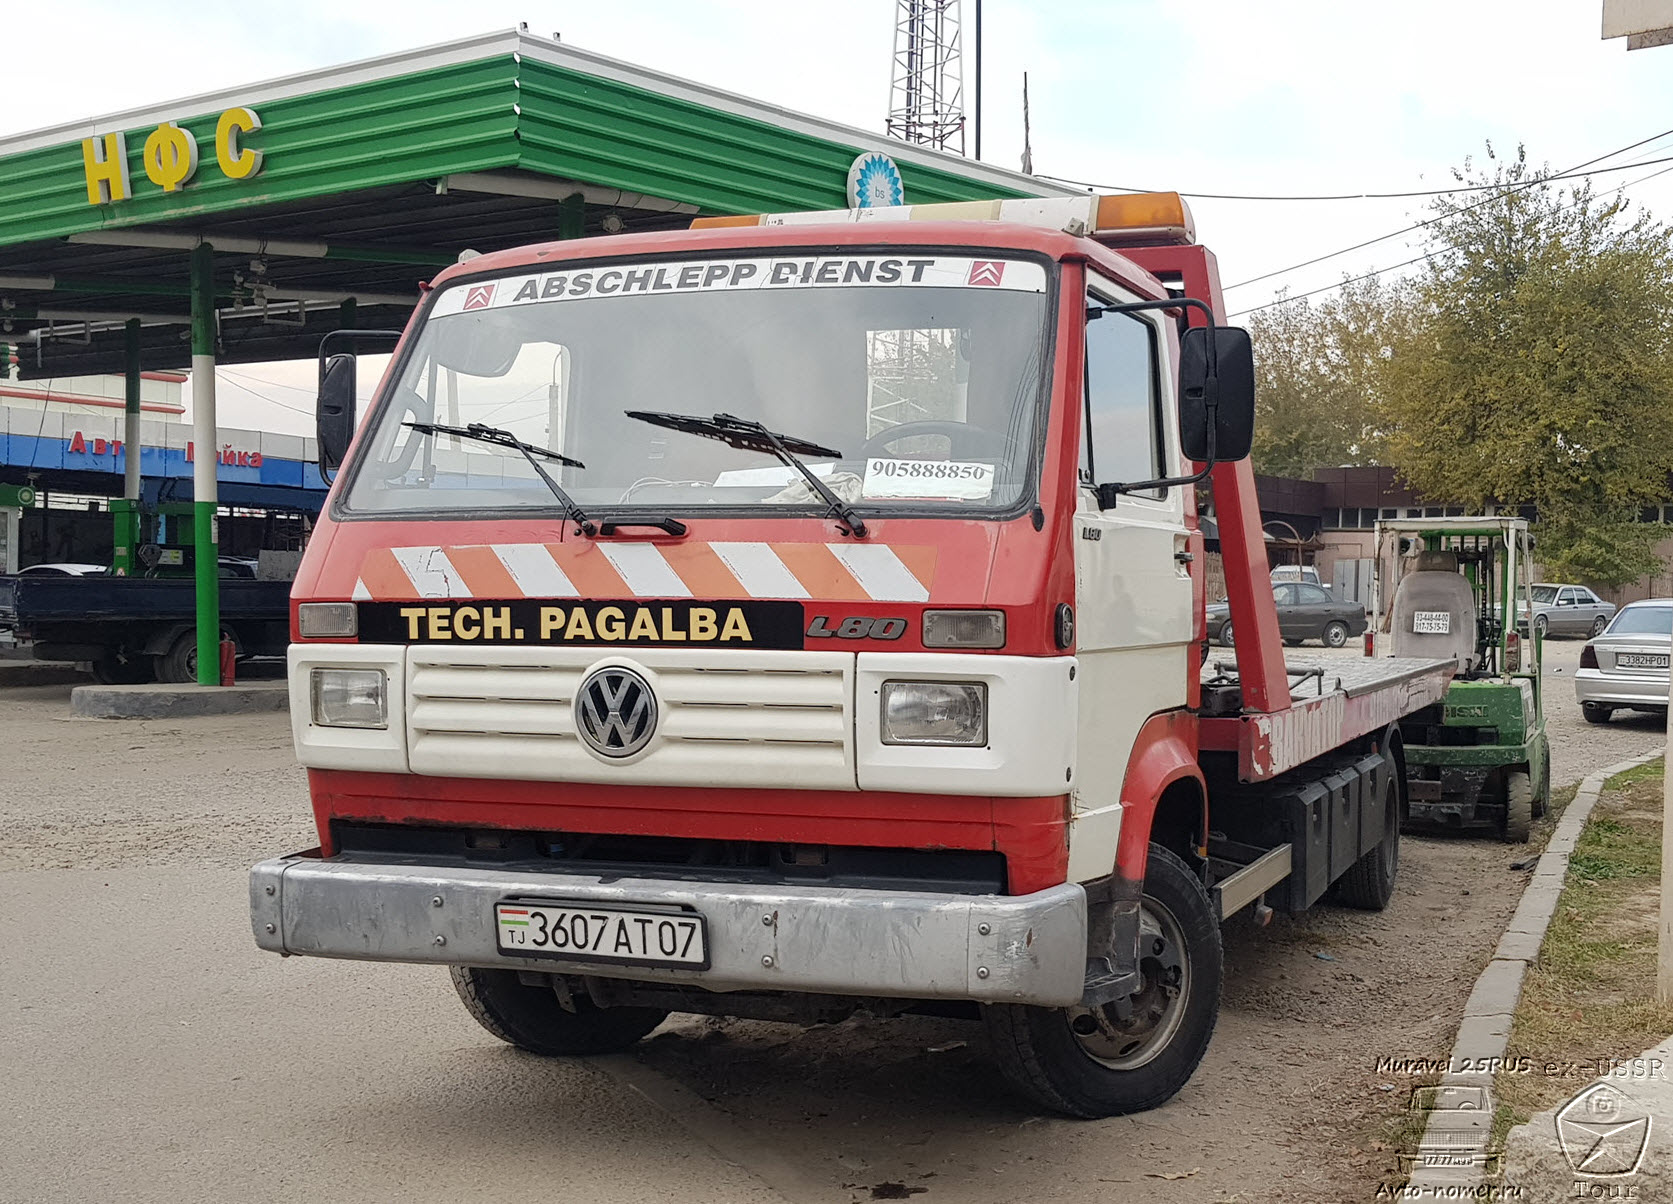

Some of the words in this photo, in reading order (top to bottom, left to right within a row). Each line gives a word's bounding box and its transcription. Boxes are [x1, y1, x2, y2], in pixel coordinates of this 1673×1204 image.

[82, 107, 262, 205] НФС
[874, 186, 886, 199] bs
[512, 263, 758, 302] ABSCHLEPP
[769, 259, 935, 285] DIENST
[68, 430, 124, 456] Авт
[872, 460, 986, 480] 905888850
[400, 606, 525, 641] TECH.
[540, 607, 754, 641] PAGALBA
[805, 616, 908, 641] L80
[508, 930, 526, 945] TJ
[530, 911, 697, 959] 3607AT07
